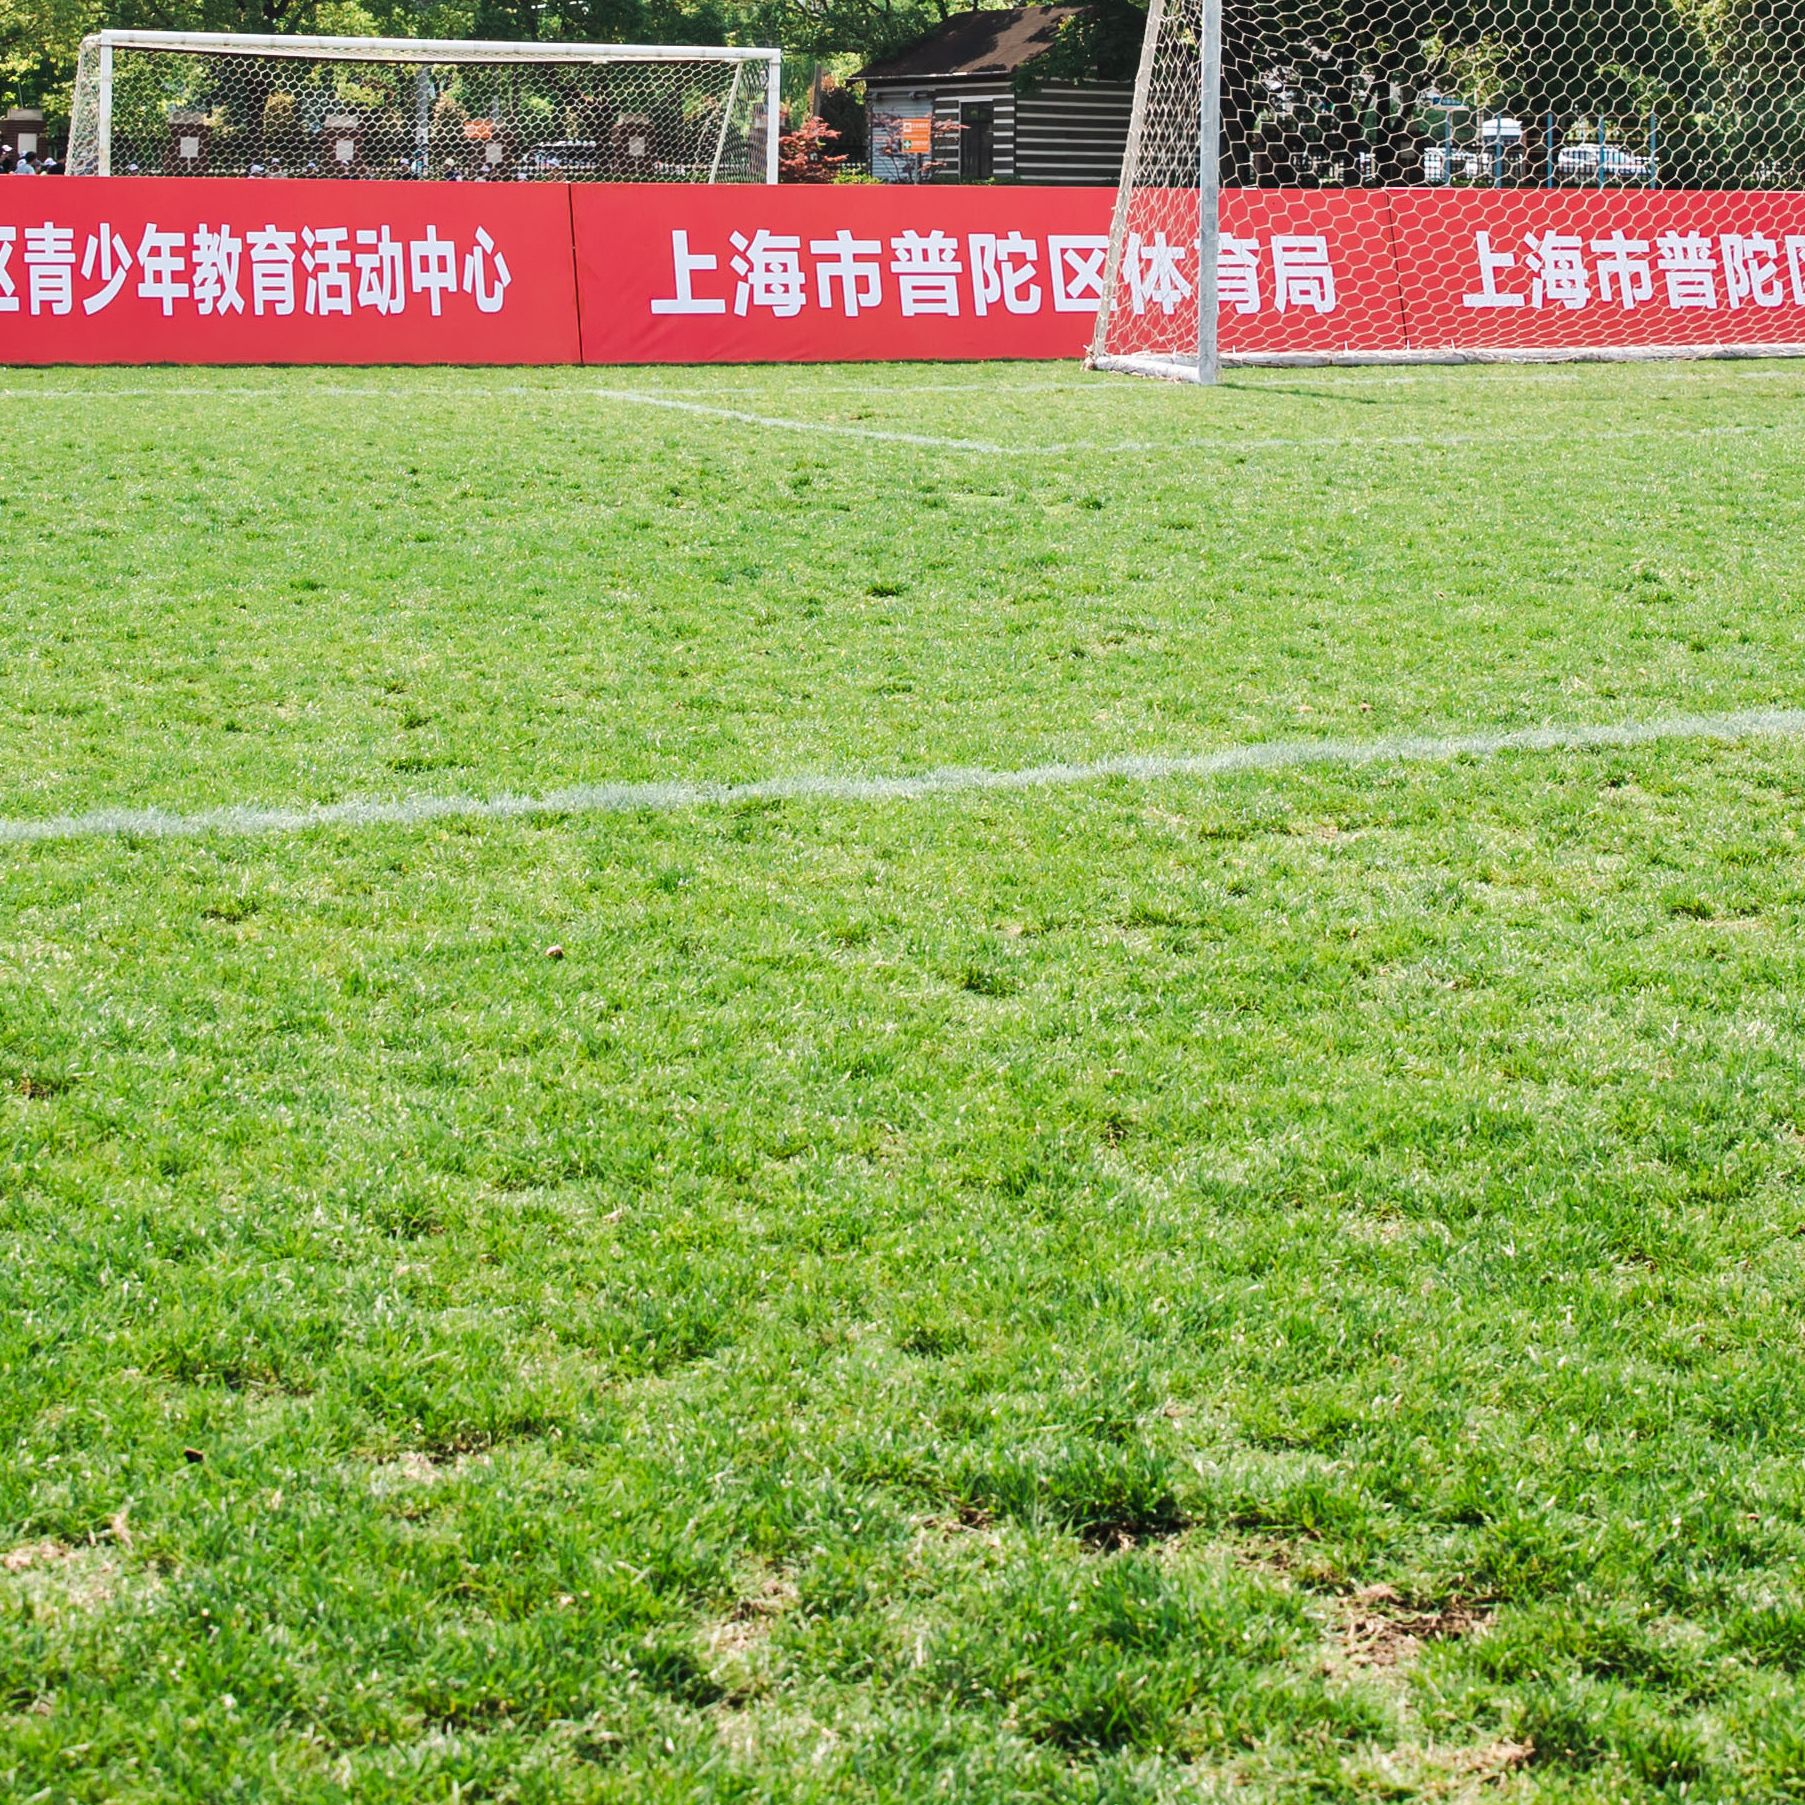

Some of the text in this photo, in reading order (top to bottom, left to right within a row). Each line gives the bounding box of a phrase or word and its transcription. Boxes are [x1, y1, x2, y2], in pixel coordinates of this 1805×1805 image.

[650, 229, 1337, 317] 上海市普陀区体育局
